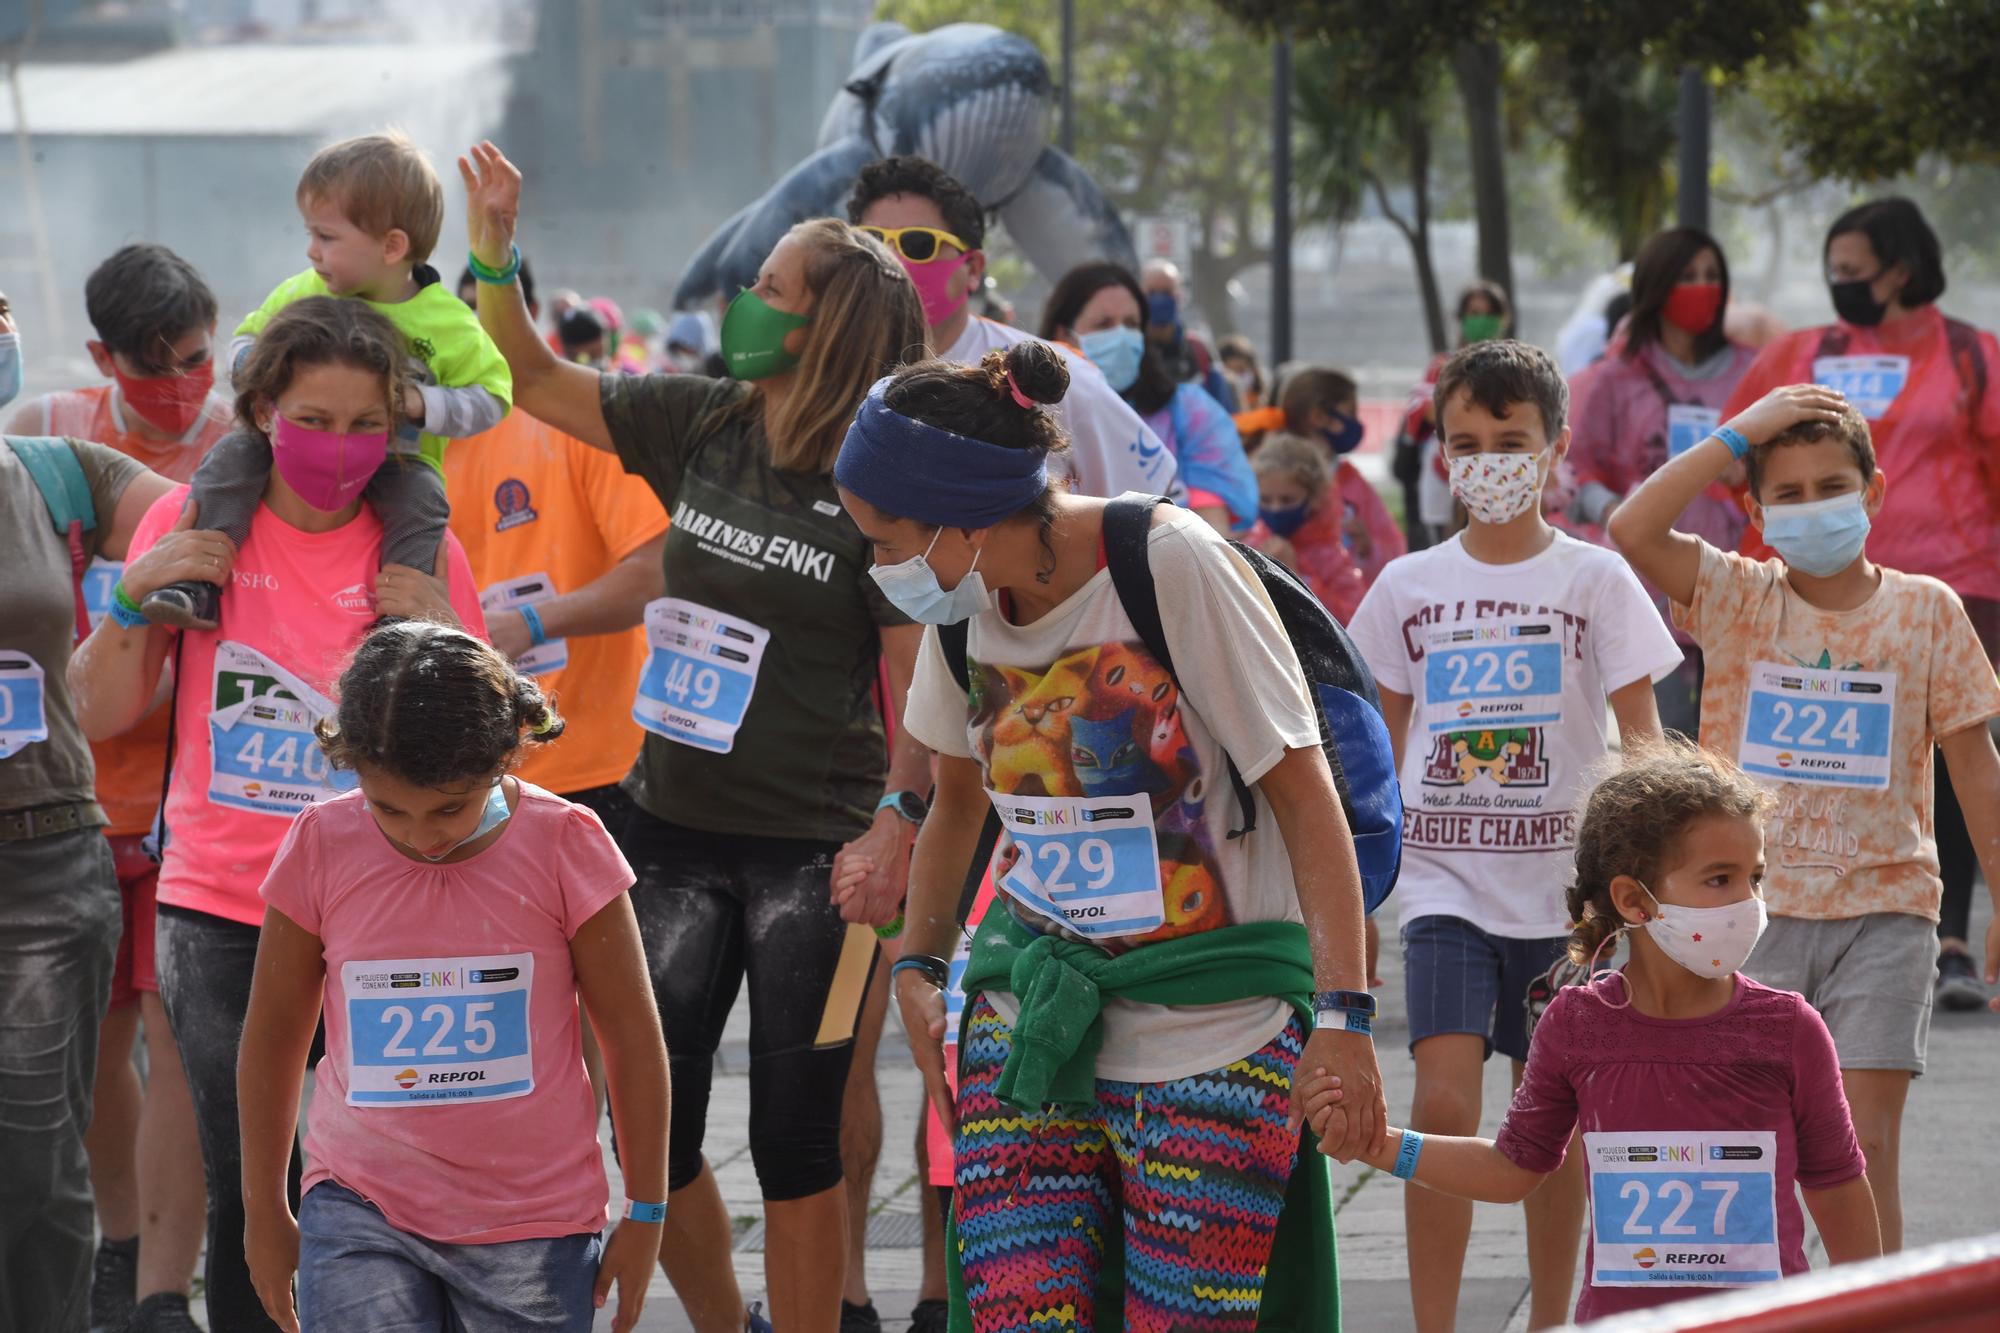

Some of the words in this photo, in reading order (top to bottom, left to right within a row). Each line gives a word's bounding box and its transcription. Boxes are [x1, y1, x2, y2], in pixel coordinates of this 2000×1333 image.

[762, 535, 836, 583] ENKI
[1446, 650, 1533, 695] 226
[664, 658, 720, 709] 449
[1480, 703, 1524, 712] REPSOL
[1771, 701, 1860, 748] 224
[236, 732, 326, 782] 440
[1800, 758, 1847, 770] REPSOL
[1517, 767, 1537, 779] 1979
[269, 790, 316, 802] REPSOL
[1422, 792, 1453, 807] West
[1455, 792, 1492, 808] State
[1494, 794, 1544, 809] Annual
[1037, 810, 1071, 826] ENKI
[1479, 816, 1577, 846] CHAMPS
[423, 971, 456, 987] ENKI
[381, 1001, 496, 1058] 225
[428, 1071, 486, 1083] REPSOL
[448, 1090, 467, 1098] 16:00
[1660, 1146, 1694, 1162] ENKI
[1620, 1180, 1739, 1235] 227
[1665, 1253, 1726, 1264] REPSOL
[1687, 1273, 1707, 1281] 16:00
